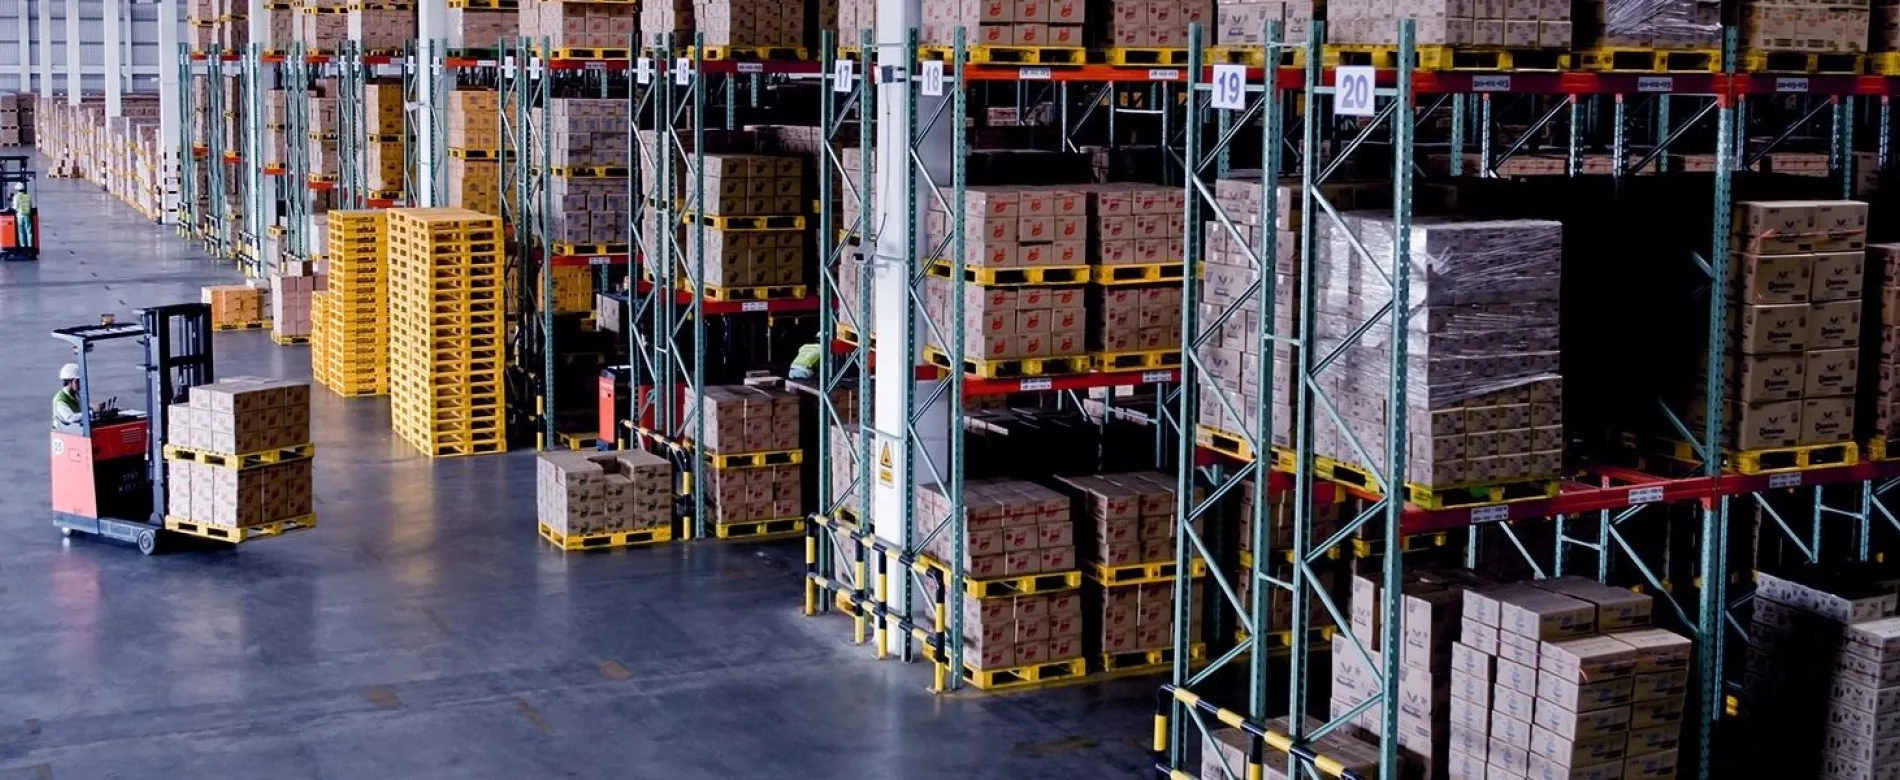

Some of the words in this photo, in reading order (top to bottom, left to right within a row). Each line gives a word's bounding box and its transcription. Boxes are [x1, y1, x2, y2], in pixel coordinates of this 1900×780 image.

[838, 65, 850, 88] 17
[926, 65, 940, 92] 18
[1218, 71, 1241, 104] 19
[1341, 73, 1369, 109] 20
